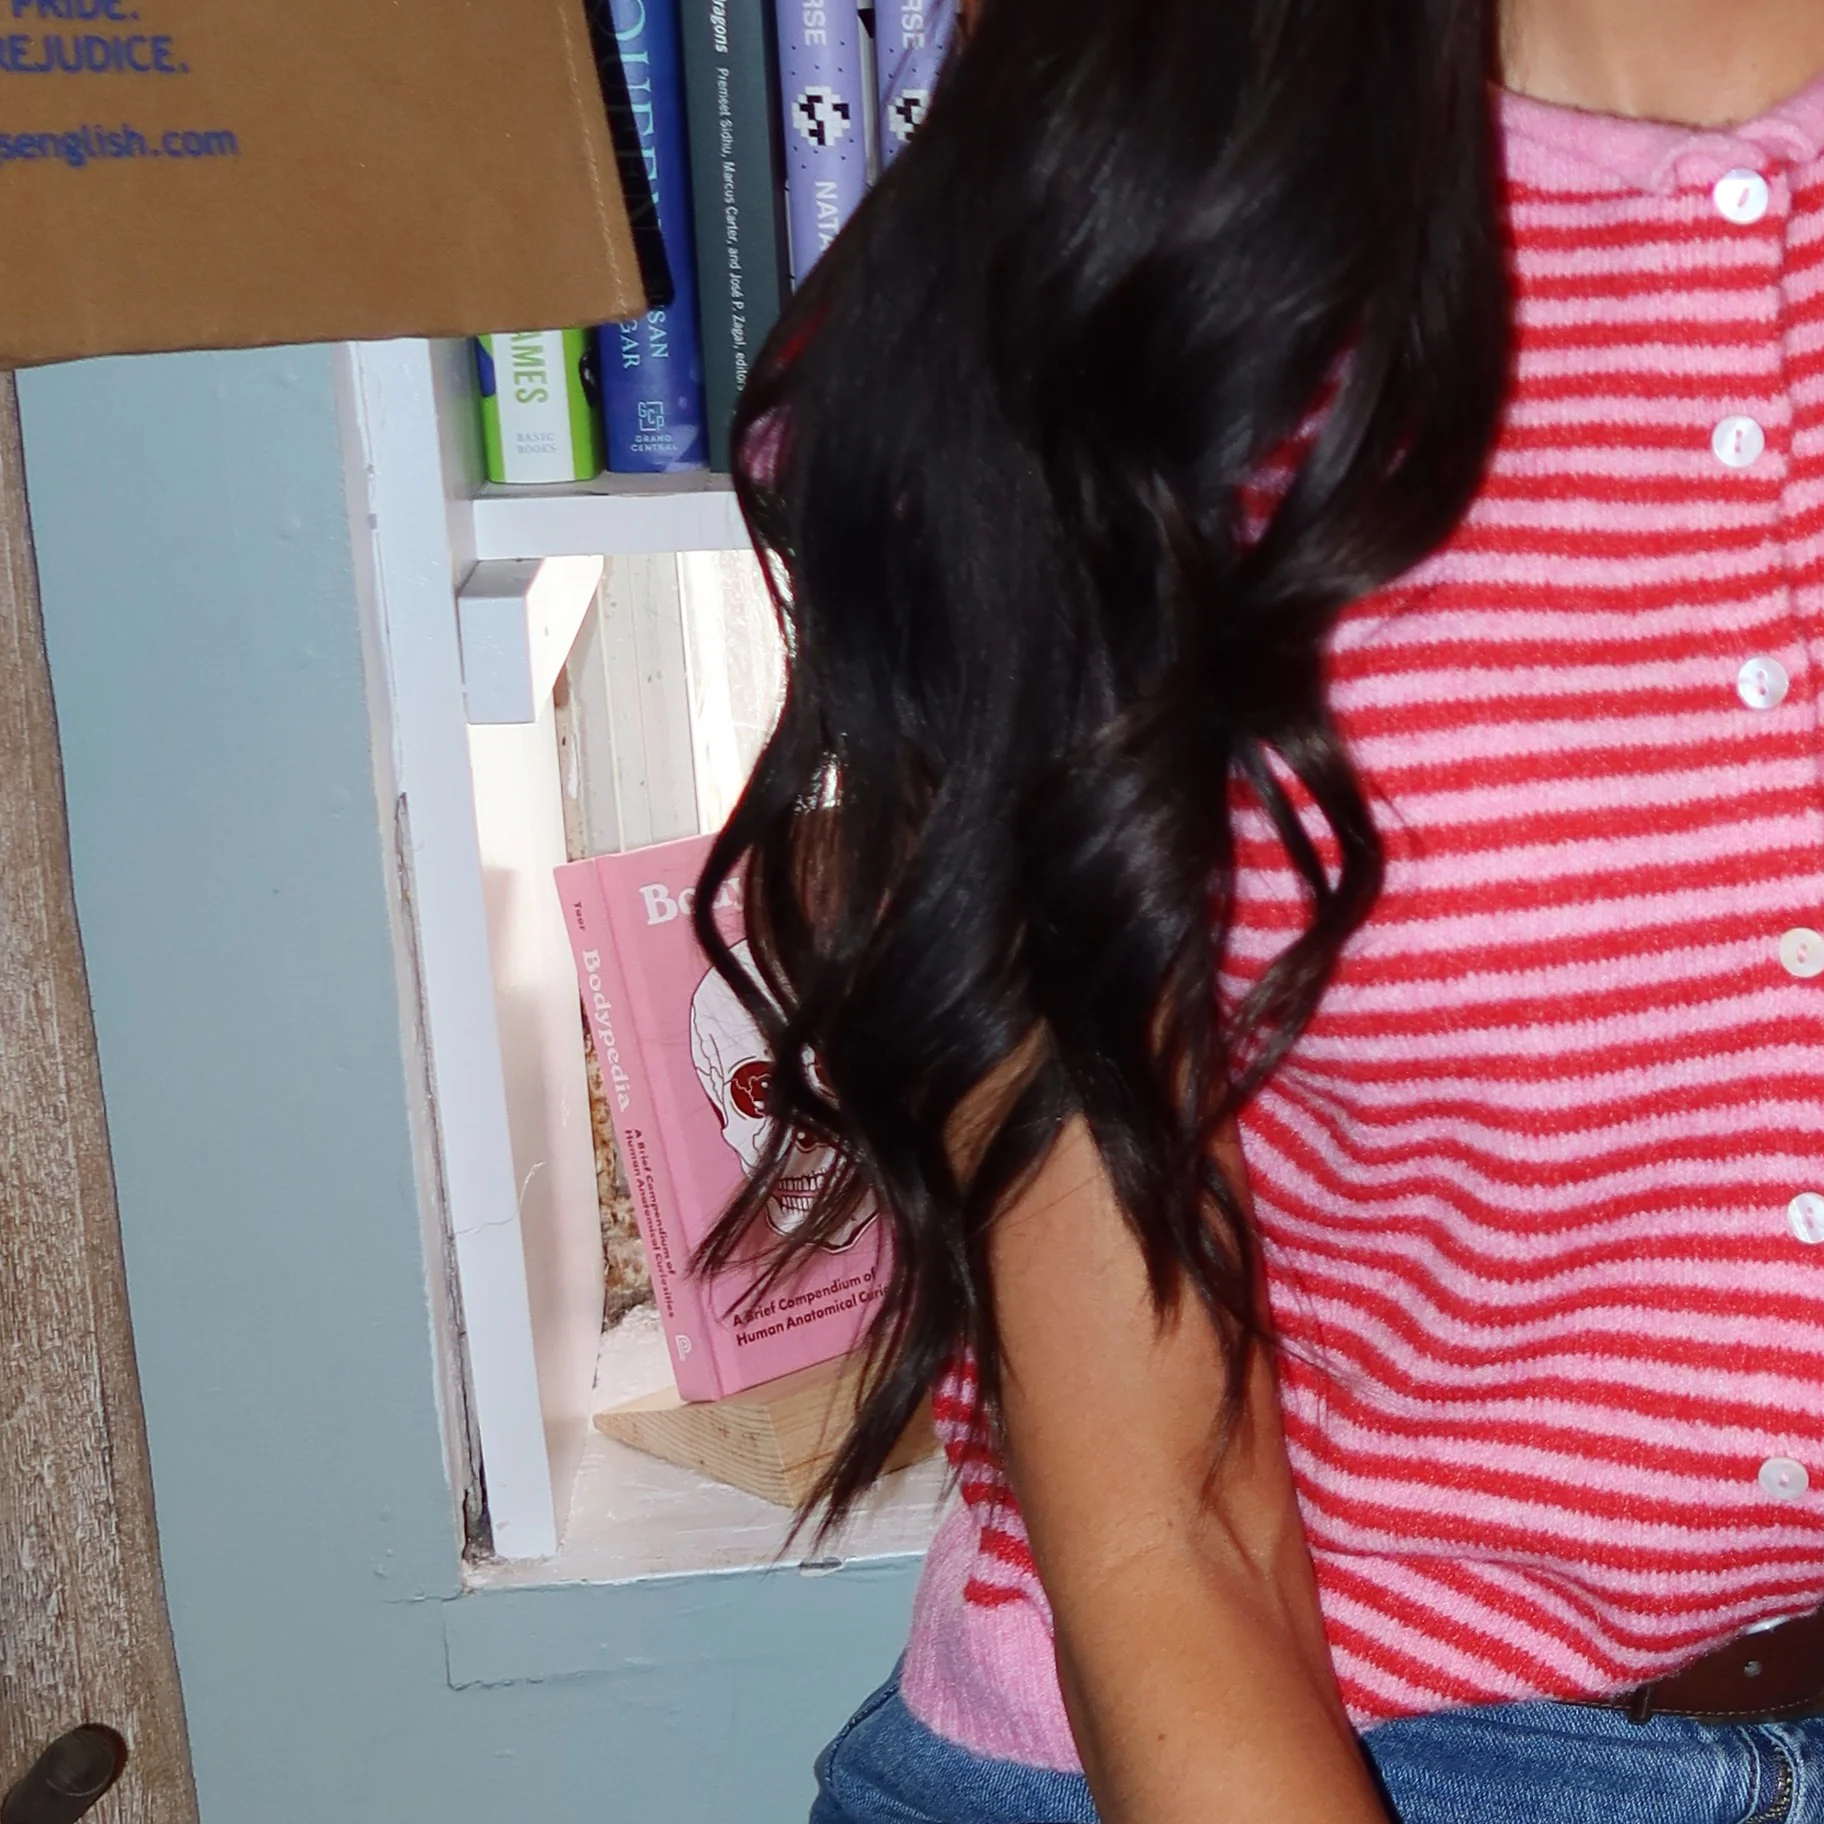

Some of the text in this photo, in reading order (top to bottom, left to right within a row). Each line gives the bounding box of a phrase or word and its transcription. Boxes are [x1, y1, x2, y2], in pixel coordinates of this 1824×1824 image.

[0, 32, 190, 74] EJUDICE.
[723, 161, 737, 202] Marcus
[725, 206, 740, 247] Carter,
[728, 248, 742, 270] and
[729, 274, 744, 301] José
[731, 303, 745, 313] P.
[510, 332, 549, 404] AMES
[517, 432, 555, 443] BASIC
[517, 444, 557, 455] BOOKS
[630, 443, 679, 452] CENTRAL
[634, 434, 673, 443] GRAND
[582, 948, 630, 1113] Bodypedia
[634, 1129, 677, 1275] A Brief Compendium of
[625, 1130, 675, 1318] Human Anatomical Curiosities
[733, 1314, 743, 1327] A
[778, 1275, 862, 1312] Compendium
[864, 1266, 877, 1282] of
[736, 1294, 858, 1347] Human Anatomical
